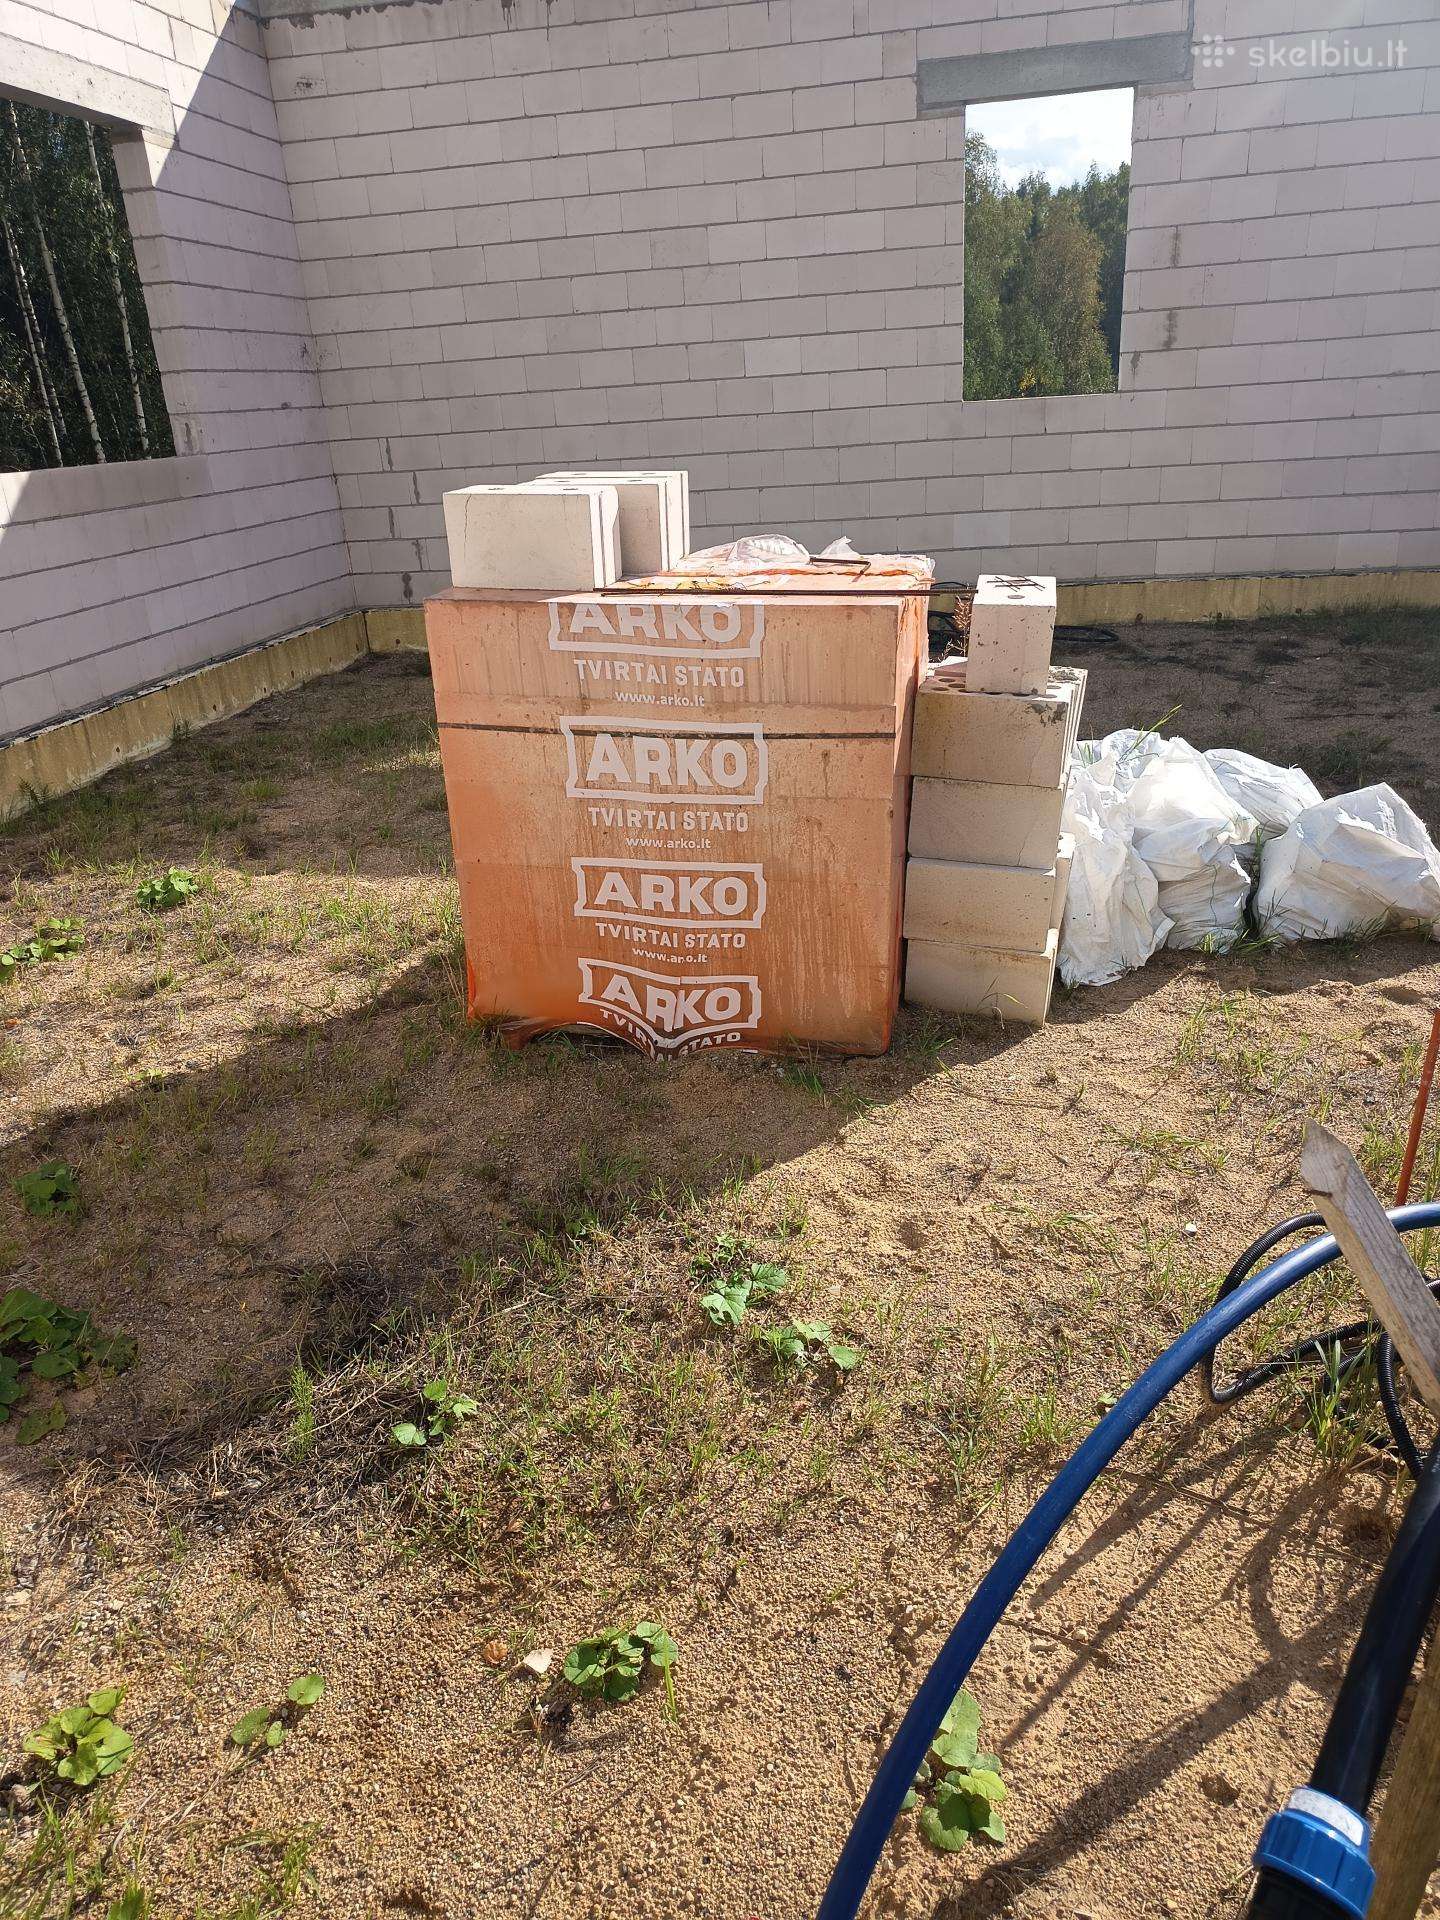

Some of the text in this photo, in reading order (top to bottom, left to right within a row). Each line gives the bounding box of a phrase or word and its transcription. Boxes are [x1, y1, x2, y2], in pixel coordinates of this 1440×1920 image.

[570, 604, 742, 643] ARKO
[574, 659, 744, 688] TVIRTAI STATO
[615, 691, 705, 707] www.arko.lt
[586, 733, 748, 788] ARKO
[588, 807, 749, 833] TVIRTAI STATO
[626, 836, 711, 850] www.arko.lt
[594, 872, 748, 916] ARKO
[595, 922, 746, 949] TVIRTAI STATO
[601, 974, 742, 1033] ARKO
